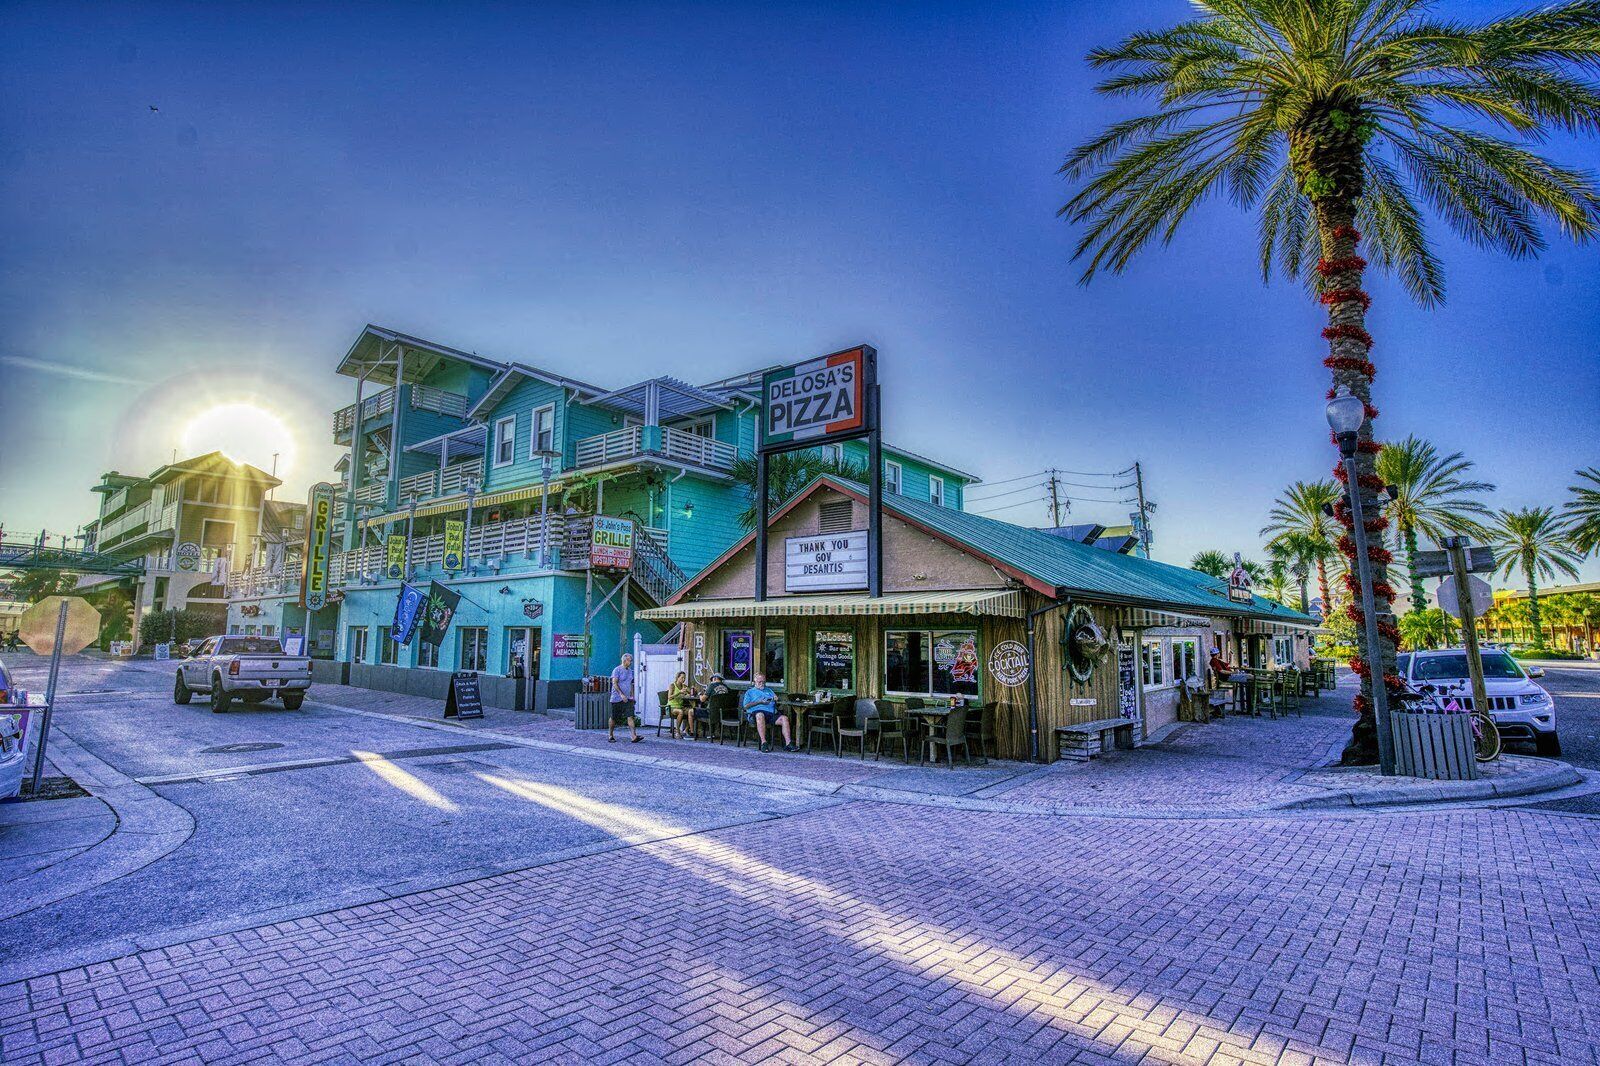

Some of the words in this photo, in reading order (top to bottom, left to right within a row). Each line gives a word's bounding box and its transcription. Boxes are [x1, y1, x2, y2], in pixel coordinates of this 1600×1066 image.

[771, 365, 853, 401] DELOSA'S
[770, 387, 853, 432] PIZZA
[605, 520, 620, 530] John's
[311, 501, 328, 591] GRILLE
[594, 530, 631, 547] GRILLE
[799, 541, 825, 553] THANK
[831, 540, 848, 550] YOU
[593, 546, 608, 555] LUNCH
[613, 549, 630, 557] DINNER
[815, 552, 832, 562] GOV
[803, 563, 843, 574] DESANTIS
[566, 641, 590, 649] CULTUR
[993, 650, 1002, 660] ICE
[1000, 643, 1013, 651] COLD
[695, 635, 704, 676] BAR
[988, 653, 1030, 672] COCKTAIL
